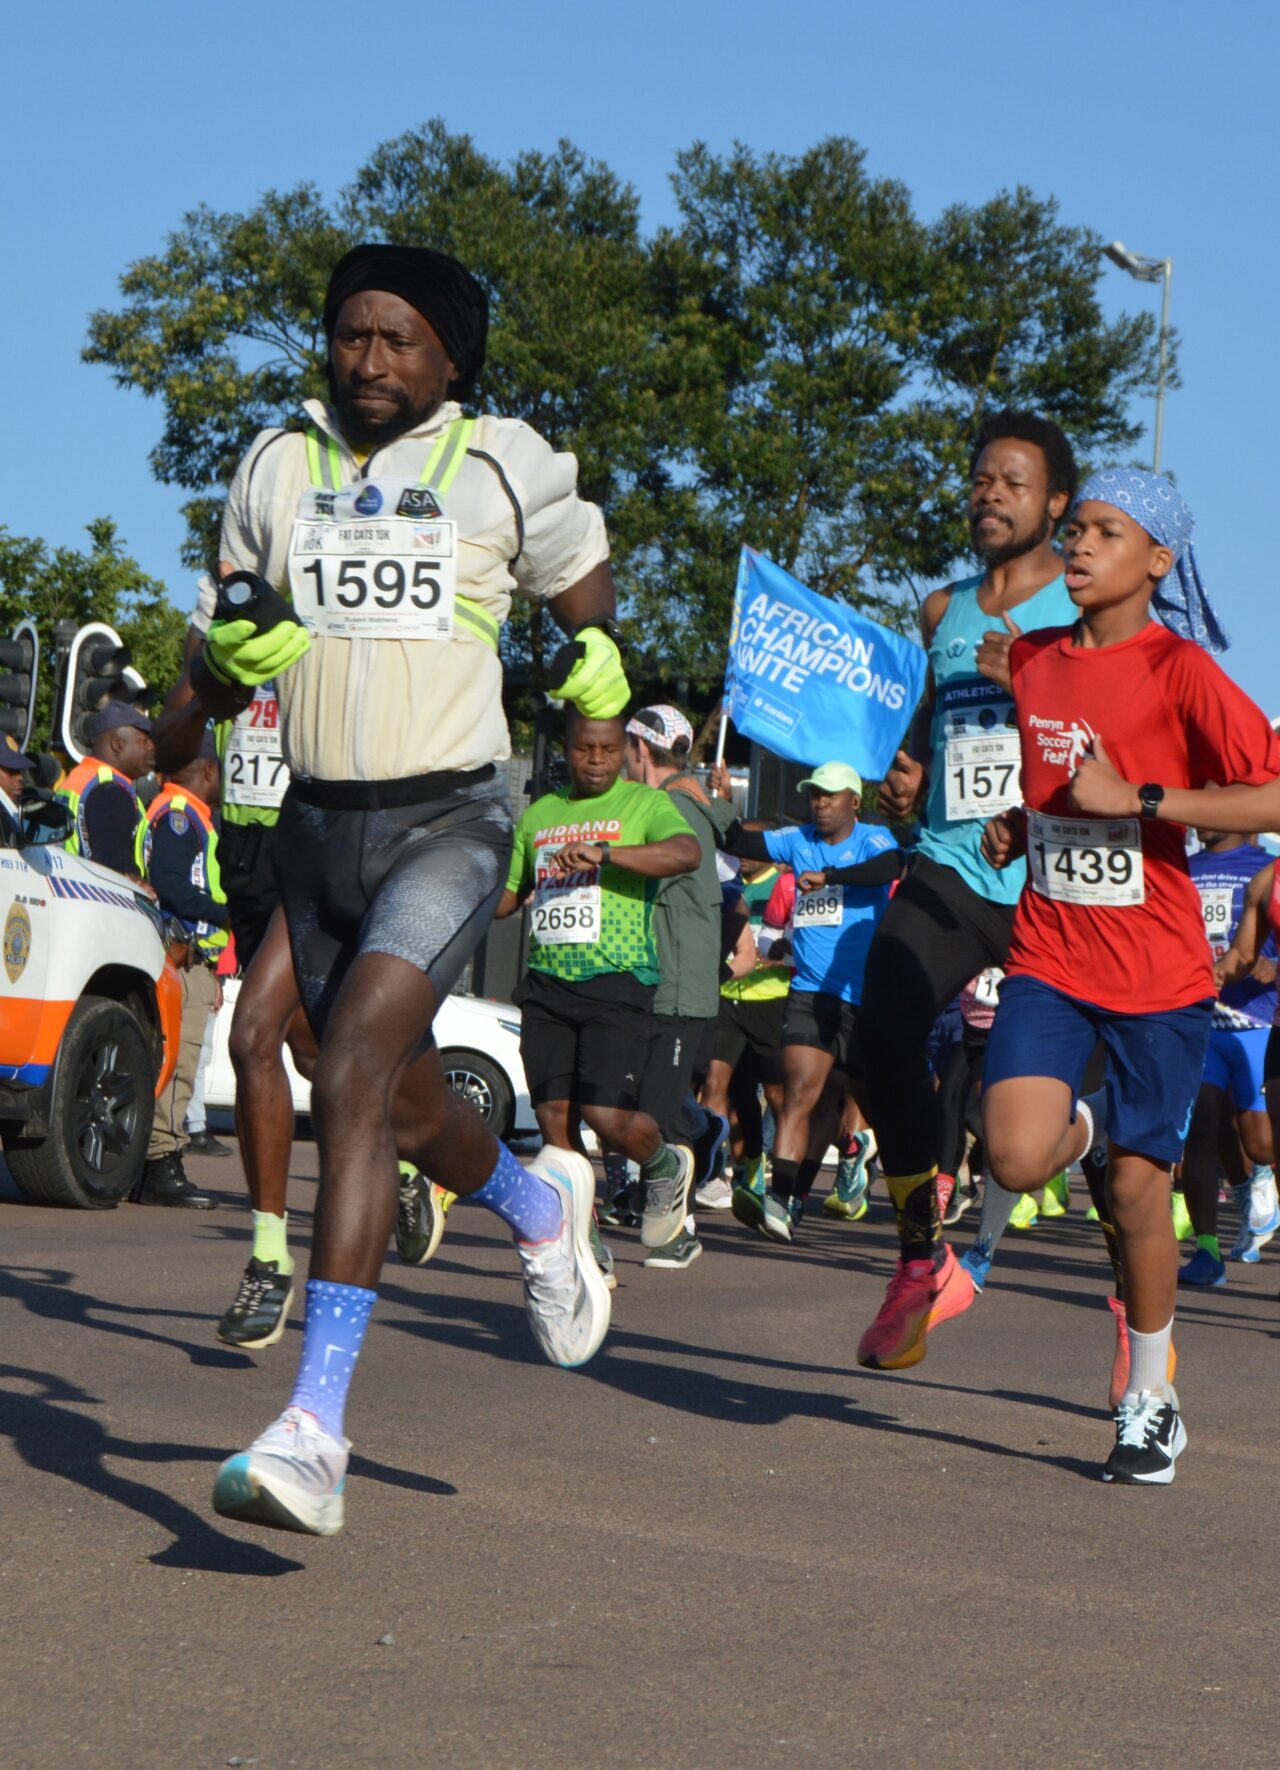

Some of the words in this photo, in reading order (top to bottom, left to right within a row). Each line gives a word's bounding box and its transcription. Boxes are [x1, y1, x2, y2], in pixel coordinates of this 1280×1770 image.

[401, 490, 436, 507] ASA
[353, 529, 375, 541] CATS
[303, 558, 442, 610] 1595
[747, 592, 875, 667] AFRICAN
[740, 616, 907, 711] CHAMPIONS
[943, 684, 1004, 702] ATHLETICS
[1028, 714, 1065, 731] Penryn
[1037, 733, 1072, 749] Soccer
[534, 819, 621, 841] MIDRAND
[1033, 841, 1133, 886] 1439
[796, 896, 839, 917] 2689
[535, 905, 595, 932] 2658
